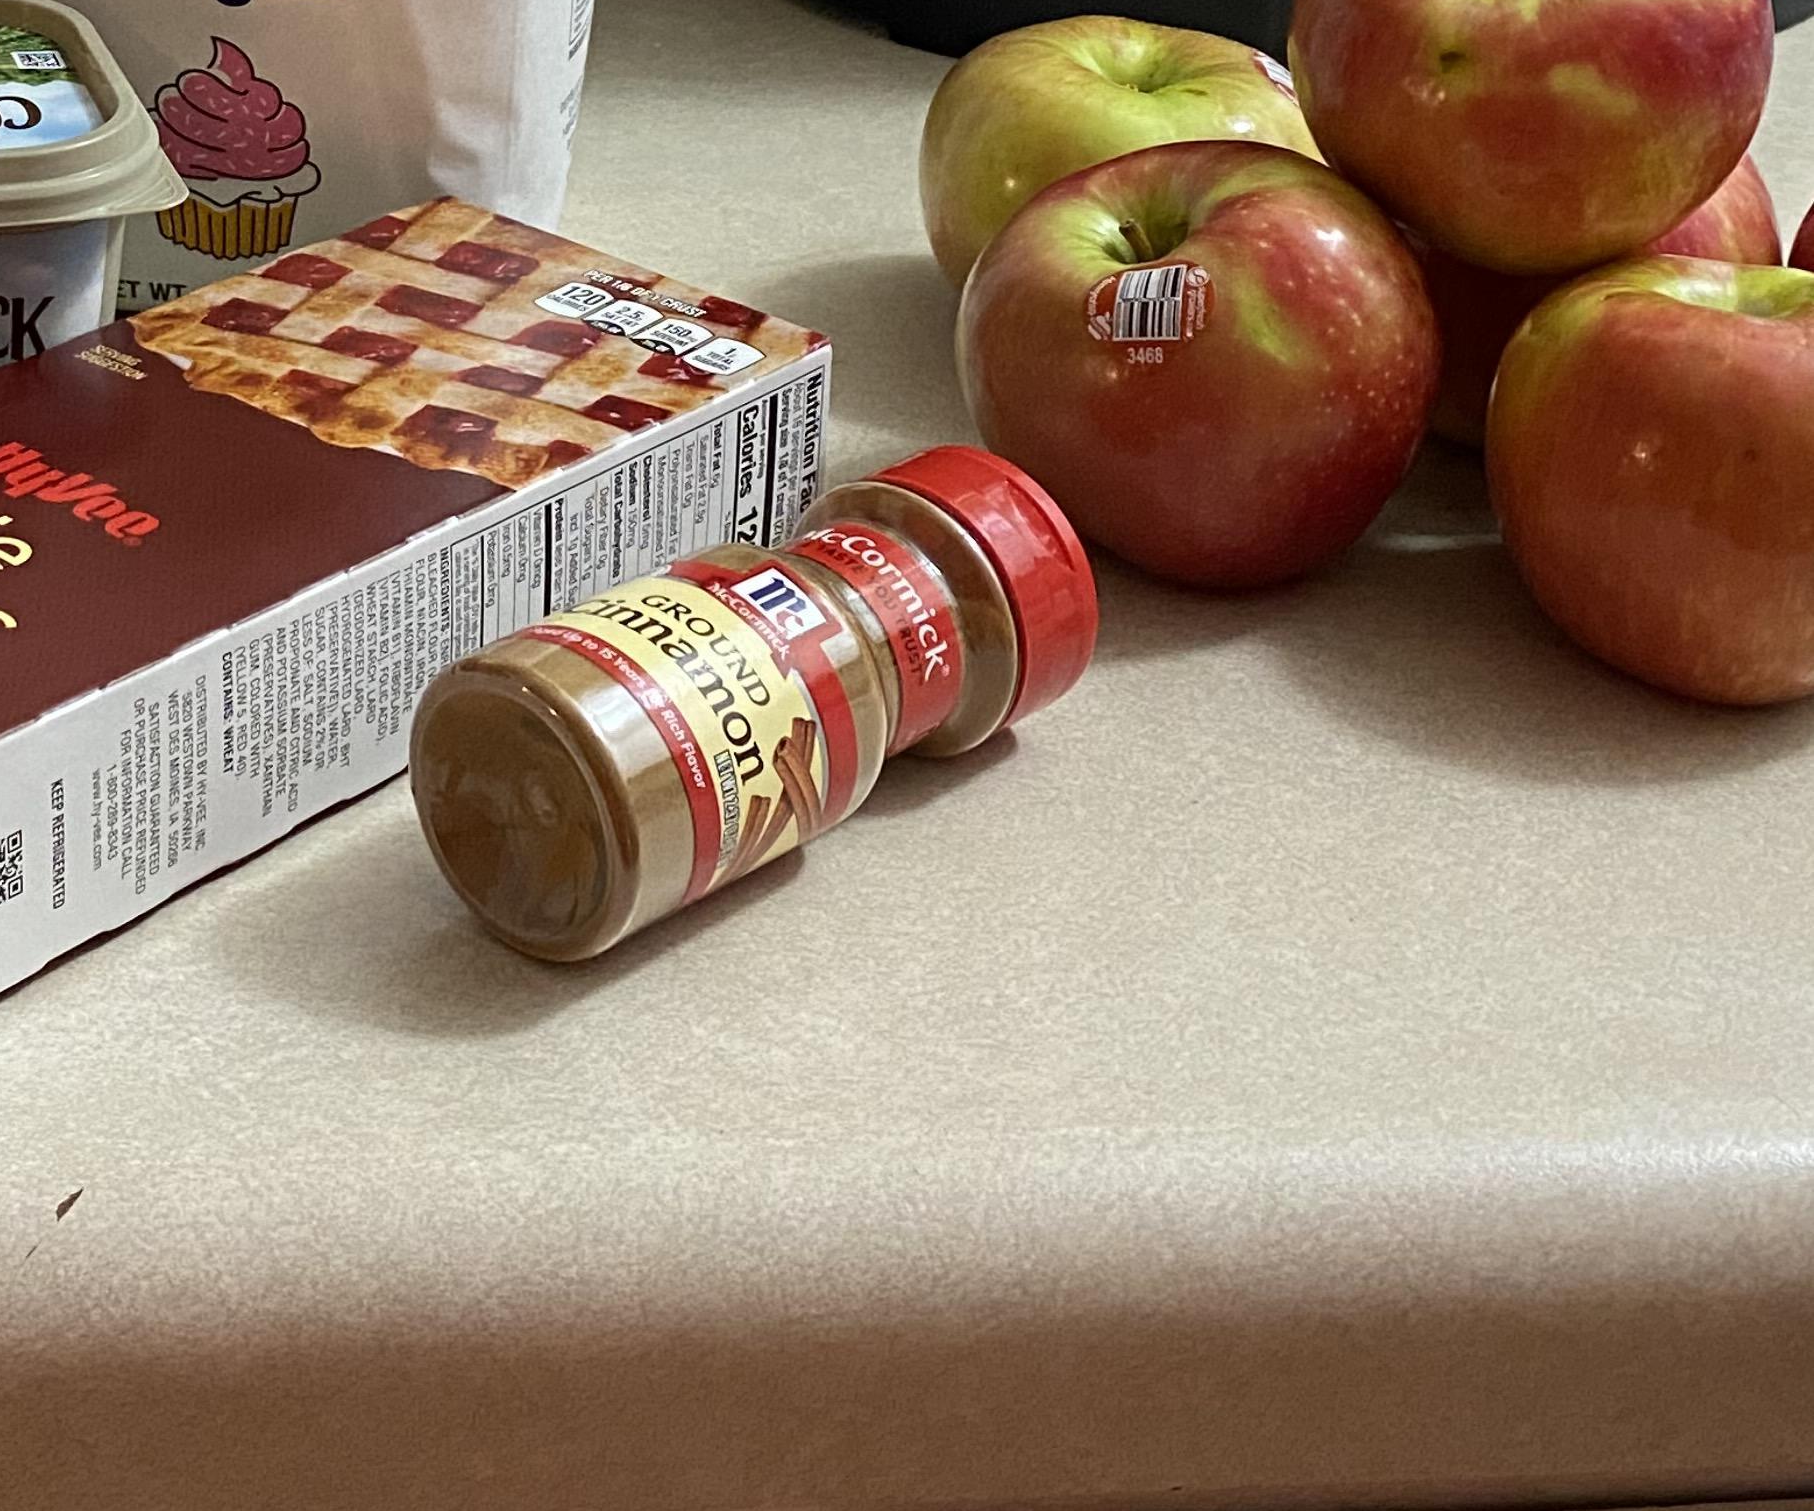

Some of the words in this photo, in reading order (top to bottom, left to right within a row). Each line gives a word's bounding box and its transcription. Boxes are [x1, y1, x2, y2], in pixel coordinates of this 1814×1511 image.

[560, 285, 607, 307] 120
[1126, 346, 1164, 364] 3468
[739, 402, 759, 499] Calories
[803, 371, 821, 469] Nutrition
[799, 470, 815, 514] Fac
[737, 504, 757, 553] 12
[440, 545, 449, 637] INGREDIENTS:
[640, 594, 771, 707] GROUND
[134, 696, 144, 718] OR
[167, 688, 178, 728] WEST
[195, 673, 207, 759] DISTRIBUTED
[221, 650, 232, 726] CONTAINS:
[120, 727, 131, 757] FOR
[134, 718, 145, 789] PURCHASE
[148, 701, 160, 793] SATISFACTION
[168, 728, 178, 756] DES
[181, 724, 193, 791] WESTOWN
[196, 758, 207, 779] BY
[222, 726, 233, 775] WHEAT
[660, 709, 686, 740] Rich
[680, 741, 708, 789] Flavor
[50, 777, 63, 814] KEEP
[119, 756, 132, 846] INFORMATION
[135, 788, 146, 828] PRICE
[180, 790, 193, 853] PARKWAY
[50, 813, 65, 911] REFRIGERATED
[120, 845, 132, 880] CALL
[134, 828, 146, 896] REFUNDED
[147, 792, 161, 877] GUARANTEED
